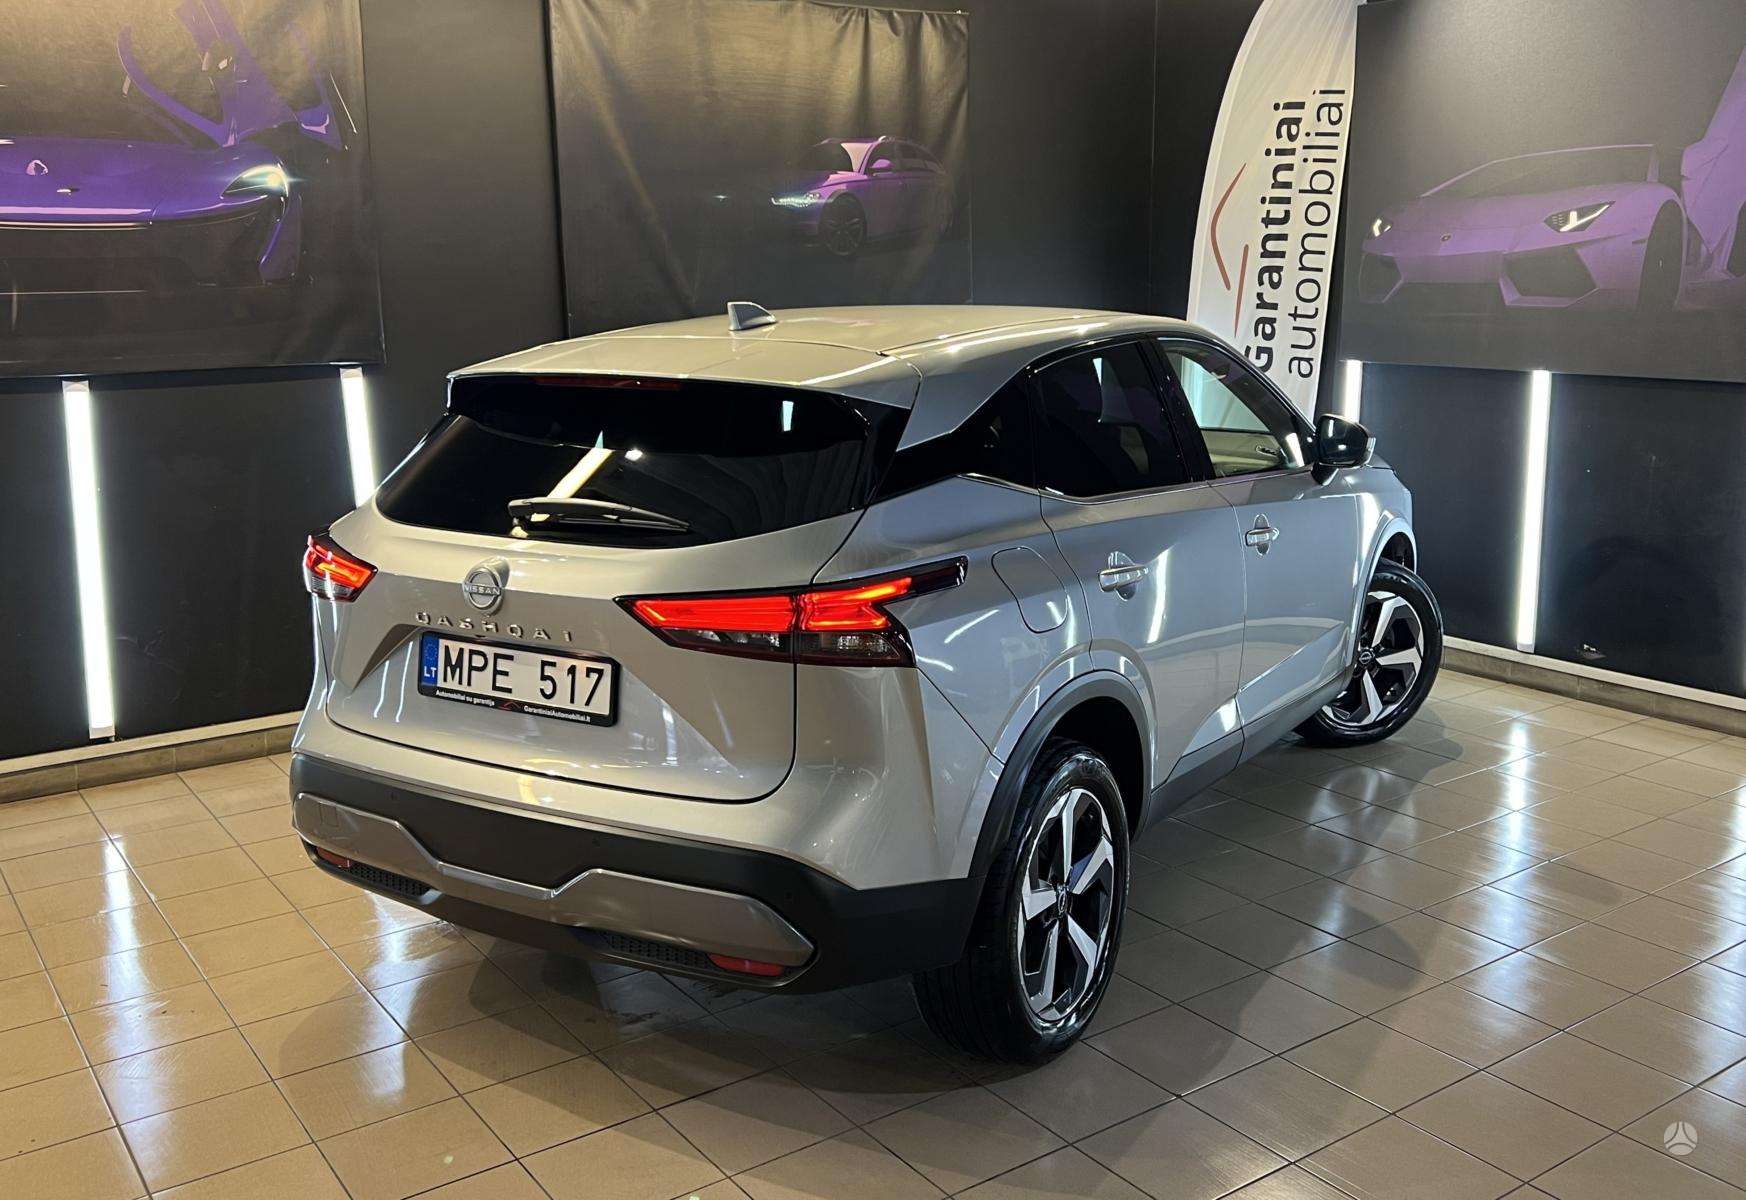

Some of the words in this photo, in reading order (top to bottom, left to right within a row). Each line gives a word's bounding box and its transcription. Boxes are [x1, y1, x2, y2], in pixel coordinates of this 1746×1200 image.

[1245, 101, 1306, 373] Garantiniai
[1288, 89, 1346, 379] automobiliai
[463, 581, 501, 596] NISSAN
[415, 611, 573, 643] QASHQAI
[423, 665, 437, 678] LT
[443, 645, 515, 694] MPE
[539, 659, 605, 707] 517
